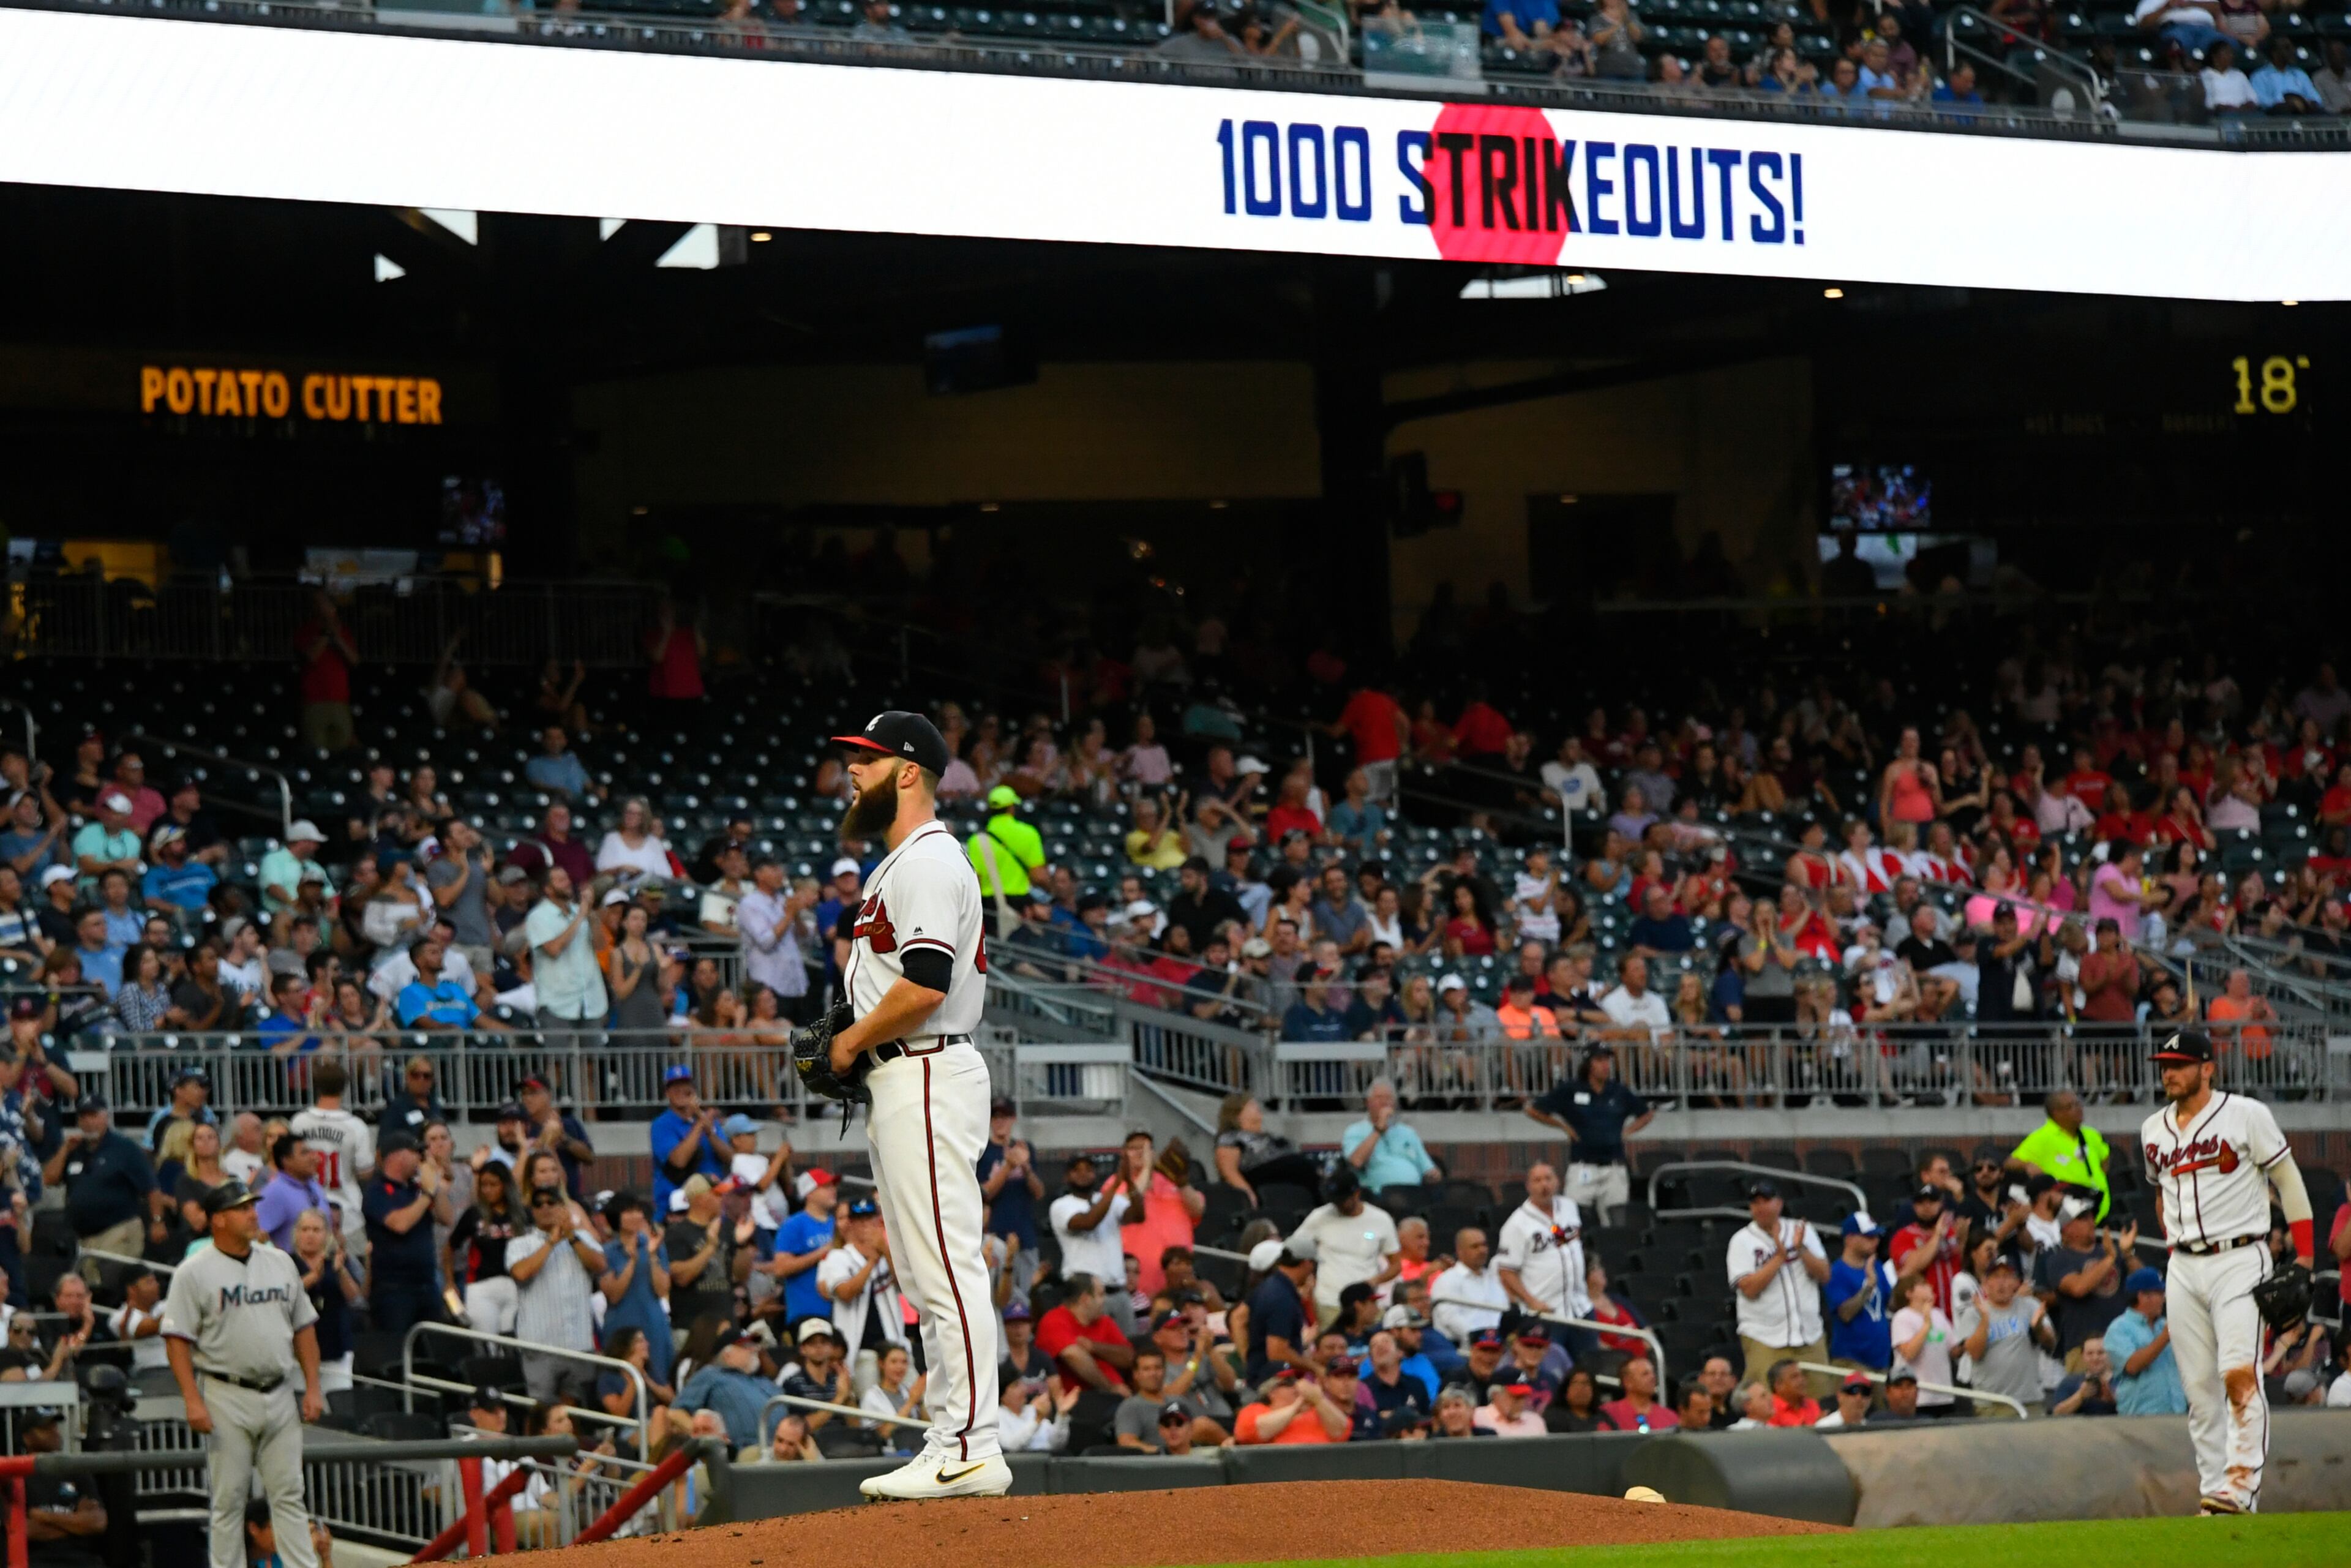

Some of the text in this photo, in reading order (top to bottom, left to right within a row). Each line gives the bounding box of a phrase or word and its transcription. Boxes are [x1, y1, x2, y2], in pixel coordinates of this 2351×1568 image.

[1216, 118, 1805, 246] 1000 STRIKEOUTS!
[141, 366, 443, 424] POTATO CUTTER
[219, 1283, 291, 1312] Miami
